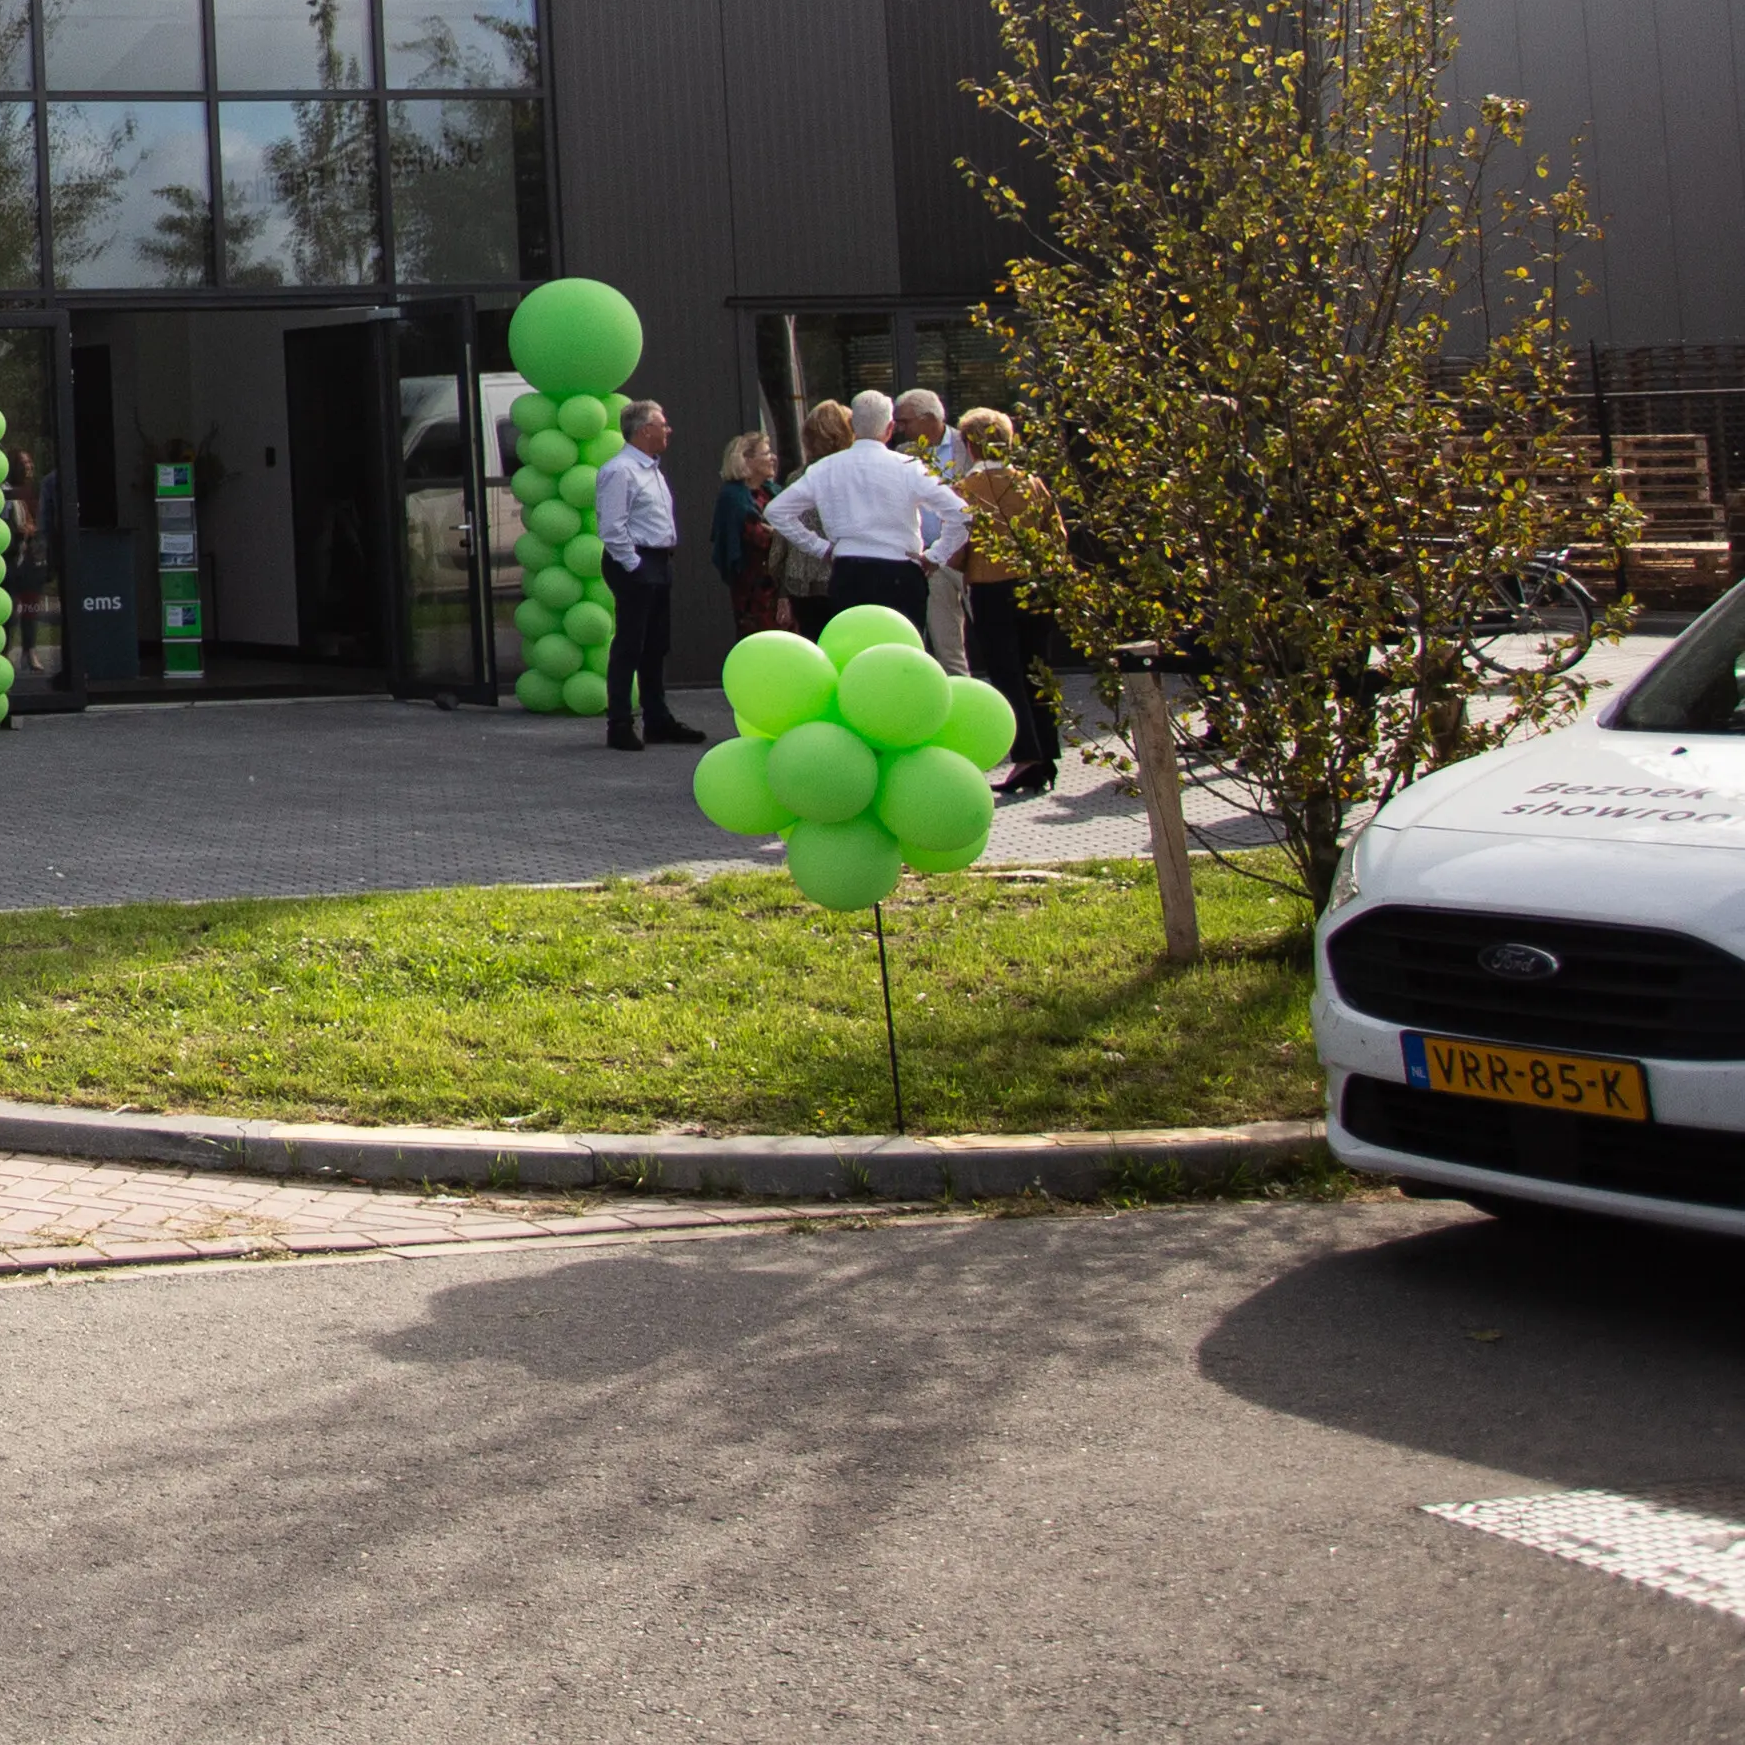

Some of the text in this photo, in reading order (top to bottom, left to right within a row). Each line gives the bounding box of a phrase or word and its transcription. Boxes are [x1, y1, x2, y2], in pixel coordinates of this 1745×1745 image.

[1524, 781, 1715, 800] Bezoek
[1500, 800, 1745, 823] showroo
[1490, 948, 1537, 973] Ford
[1432, 1045, 1630, 1111] VRR-85-K
